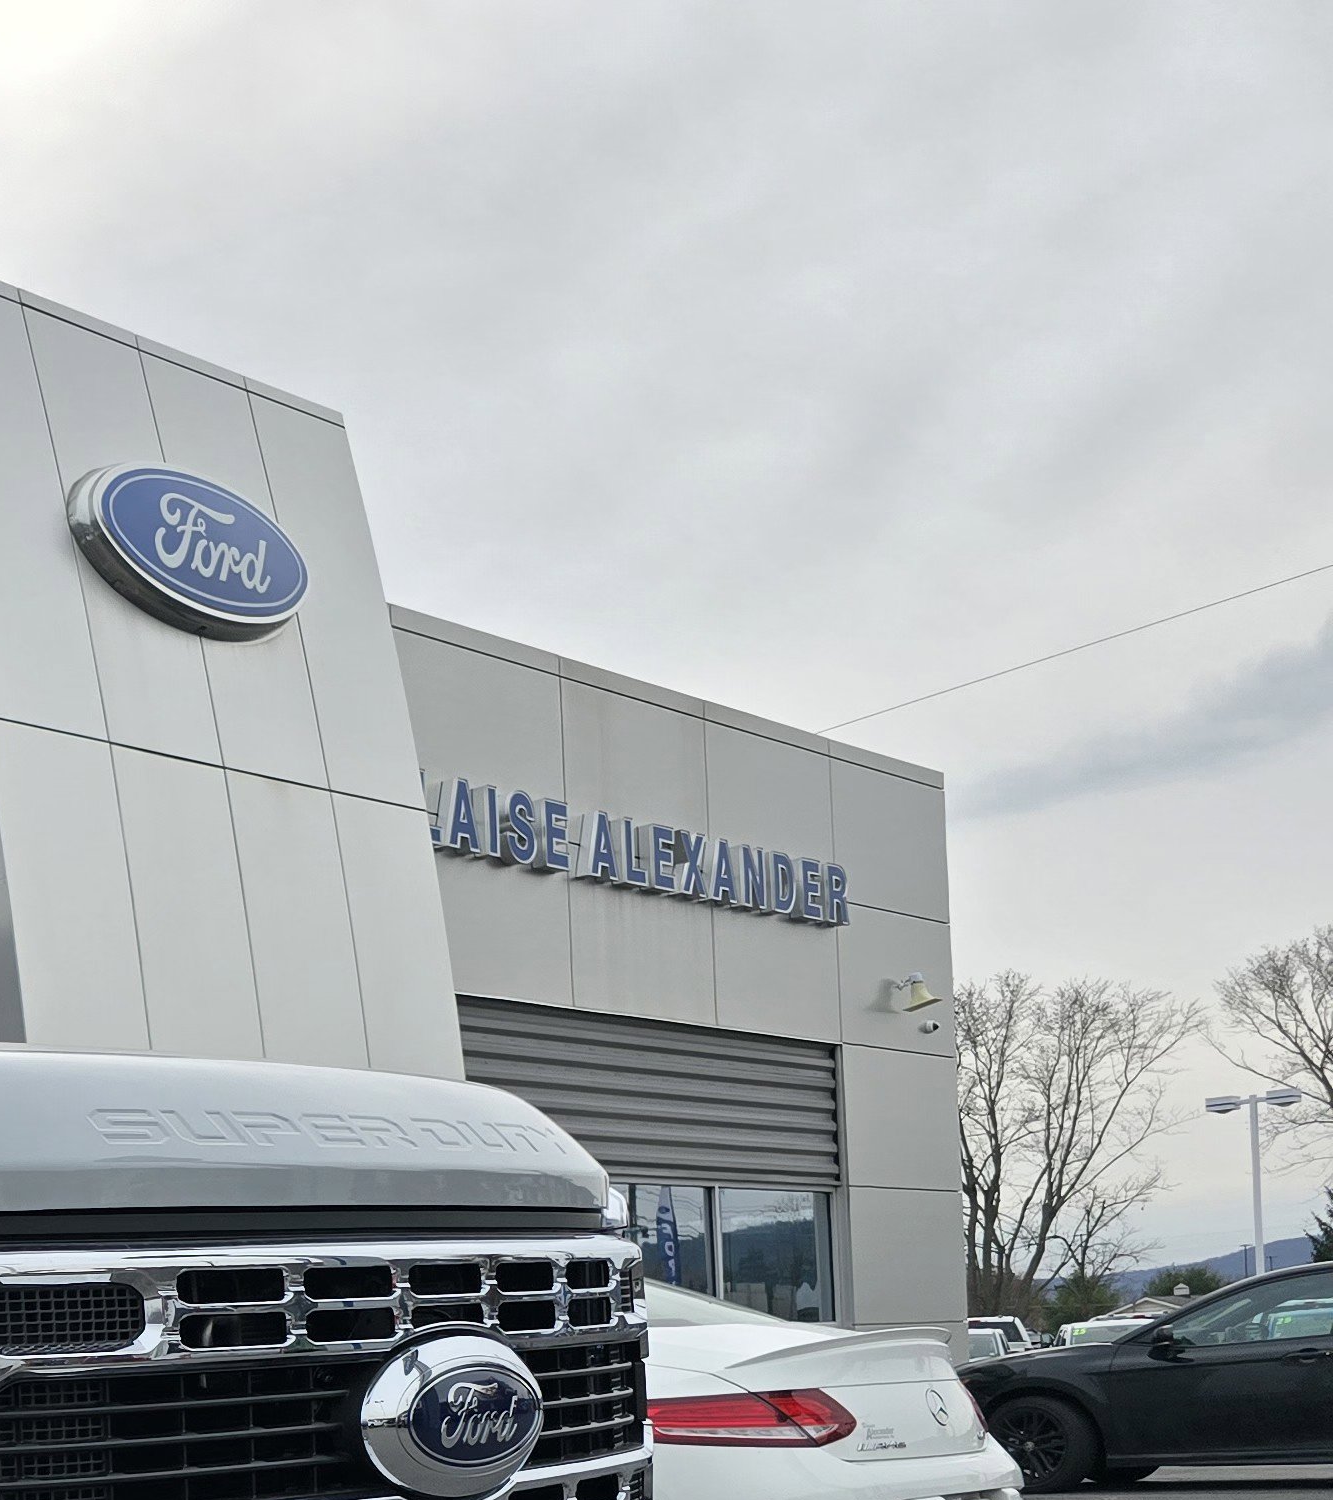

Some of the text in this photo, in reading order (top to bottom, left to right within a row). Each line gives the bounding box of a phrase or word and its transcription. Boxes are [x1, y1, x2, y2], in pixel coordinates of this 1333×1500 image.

[155, 492, 271, 594] Ford
[590, 811, 850, 926] ALEXANDER
[86, 1108, 420, 1151] SUPER
[441, 1382, 518, 1448] Ford
